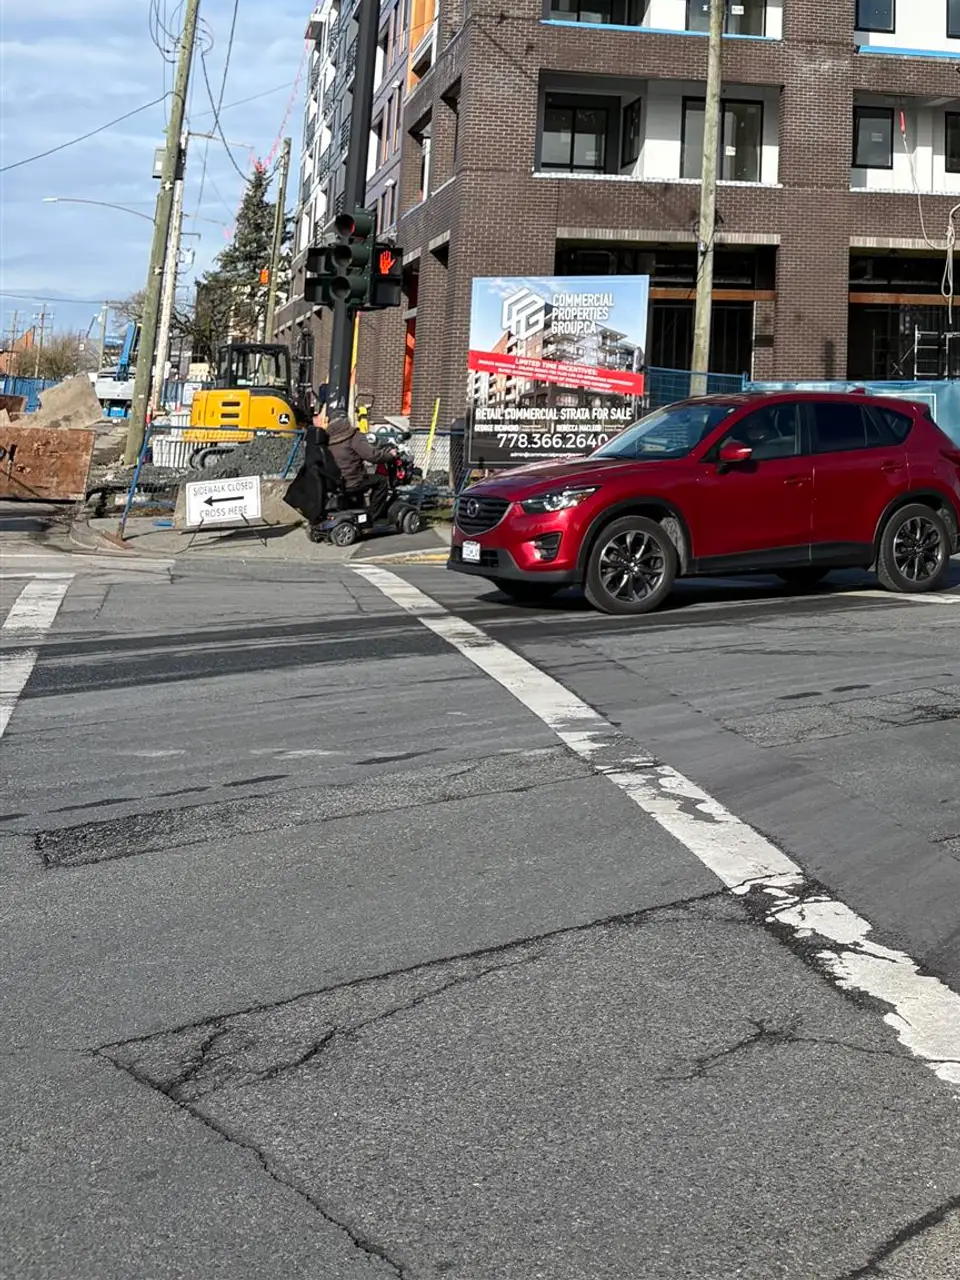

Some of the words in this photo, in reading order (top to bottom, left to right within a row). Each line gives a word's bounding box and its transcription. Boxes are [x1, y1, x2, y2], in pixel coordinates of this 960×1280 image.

[552, 293, 615, 307] COMMERCIAL
[552, 307, 609, 321] PROPERTIES
[475, 407, 504, 420] RETAIL
[504, 407, 559, 420] COMMERCIAL
[560, 407, 590, 420] STRATA
[592, 407, 609, 420] FOR
[610, 407, 632, 420] SALE
[496, 433, 609, 448] 778.366.2640
[228, 481, 253, 492] CLOSED
[200, 508, 225, 518] CROSS
[228, 505, 248, 516] HERE
